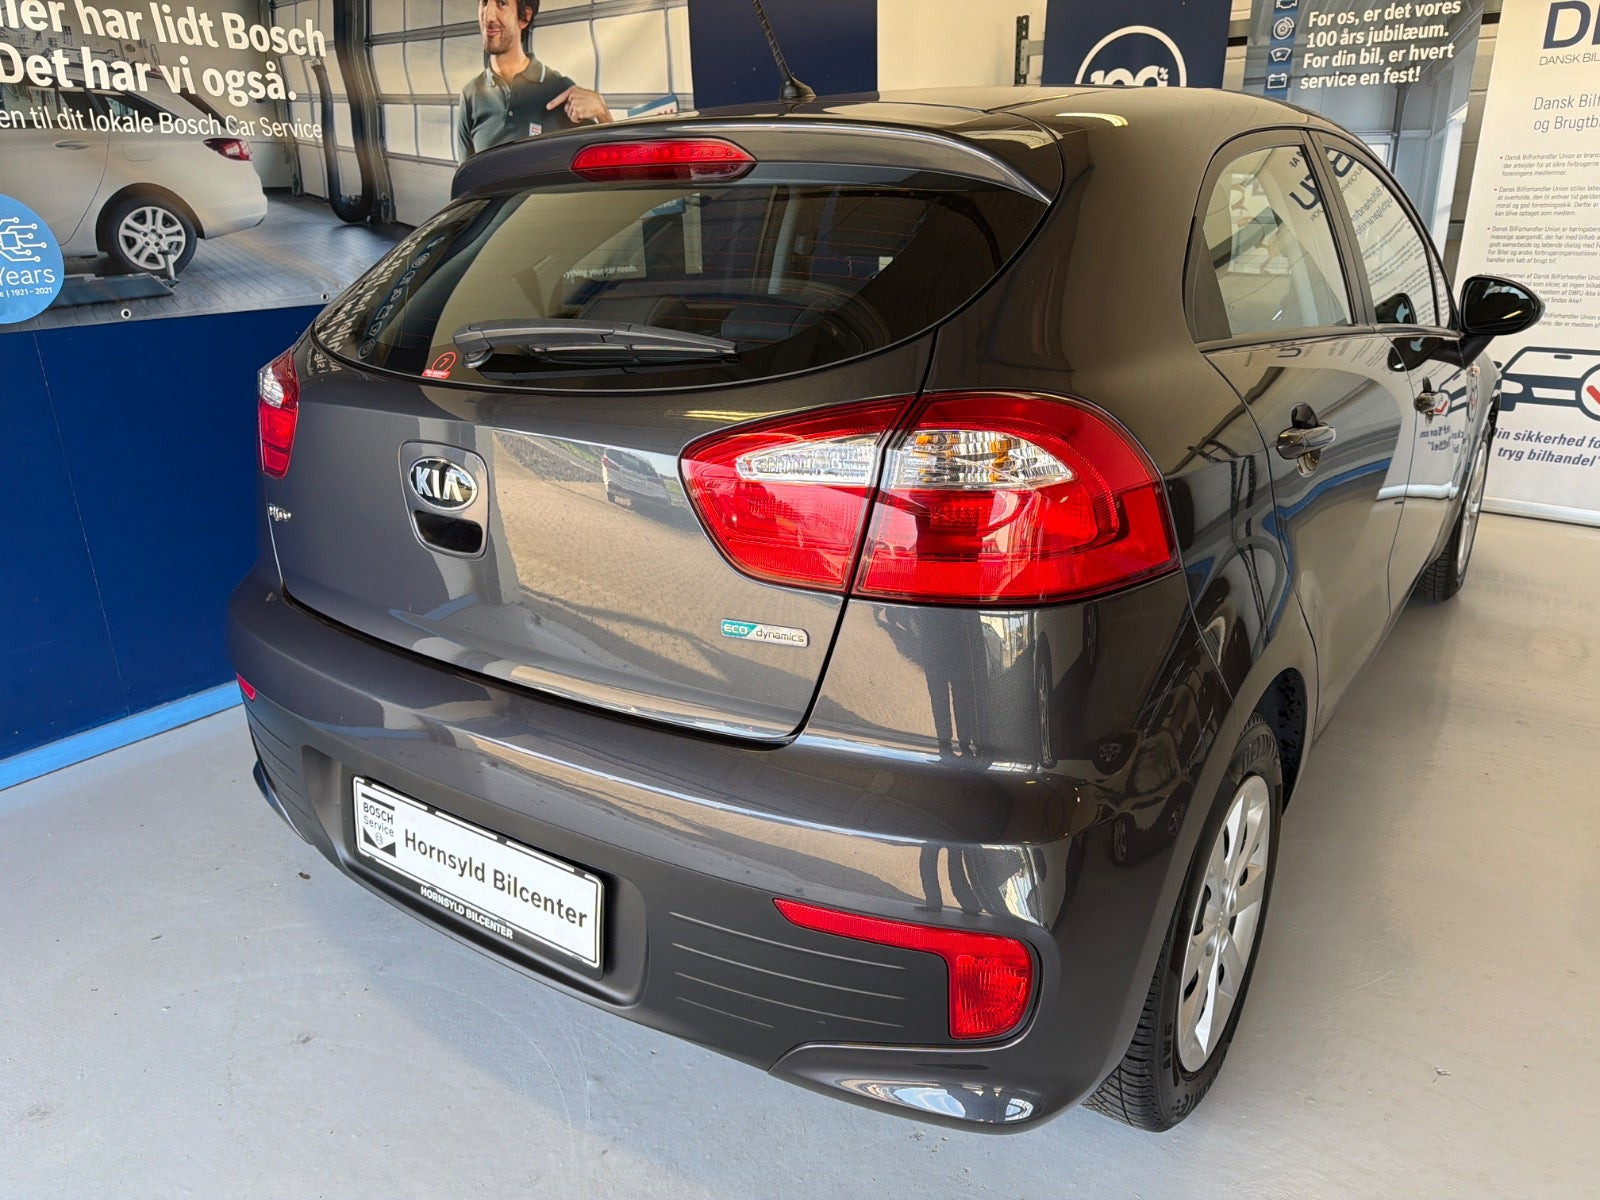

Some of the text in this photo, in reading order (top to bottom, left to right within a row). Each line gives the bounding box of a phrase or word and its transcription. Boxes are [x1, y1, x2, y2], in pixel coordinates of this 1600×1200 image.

[1308, 0, 1462, 27] For os, er det vores
[0, 0, 326, 56] ler har lidt Bosch
[1306, 24, 1450, 48] 100 års jubilæum.
[1303, 42, 1454, 68] For din bil, er hvert
[1540, 54, 1580, 66] DANSK
[0, 42, 297, 107] Det har vi også.
[1300, 66, 1420, 89] service en fest!
[1534, 95, 1574, 110] Dansk
[30, 106, 52, 129] til
[57, 107, 88, 131] dit
[90, 108, 154, 133] lokale
[159, 112, 222, 136] Bosch
[225, 114, 256, 136] Car
[260, 117, 322, 138] Service
[1534, 115, 1600, 133] og Brugtb
[1513, 430, 1586, 447] sikkerhed
[1498, 447, 1524, 462] tryg
[415, 466, 464, 502] KIA
[724, 624, 804, 642] ECO dynamics
[363, 802, 394, 825] BOSCH
[364, 815, 394, 837] Service
[404, 828, 588, 928] Hornsyld Bilcenter
[420, 886, 514, 940] HORNSYLD BILCENTER
